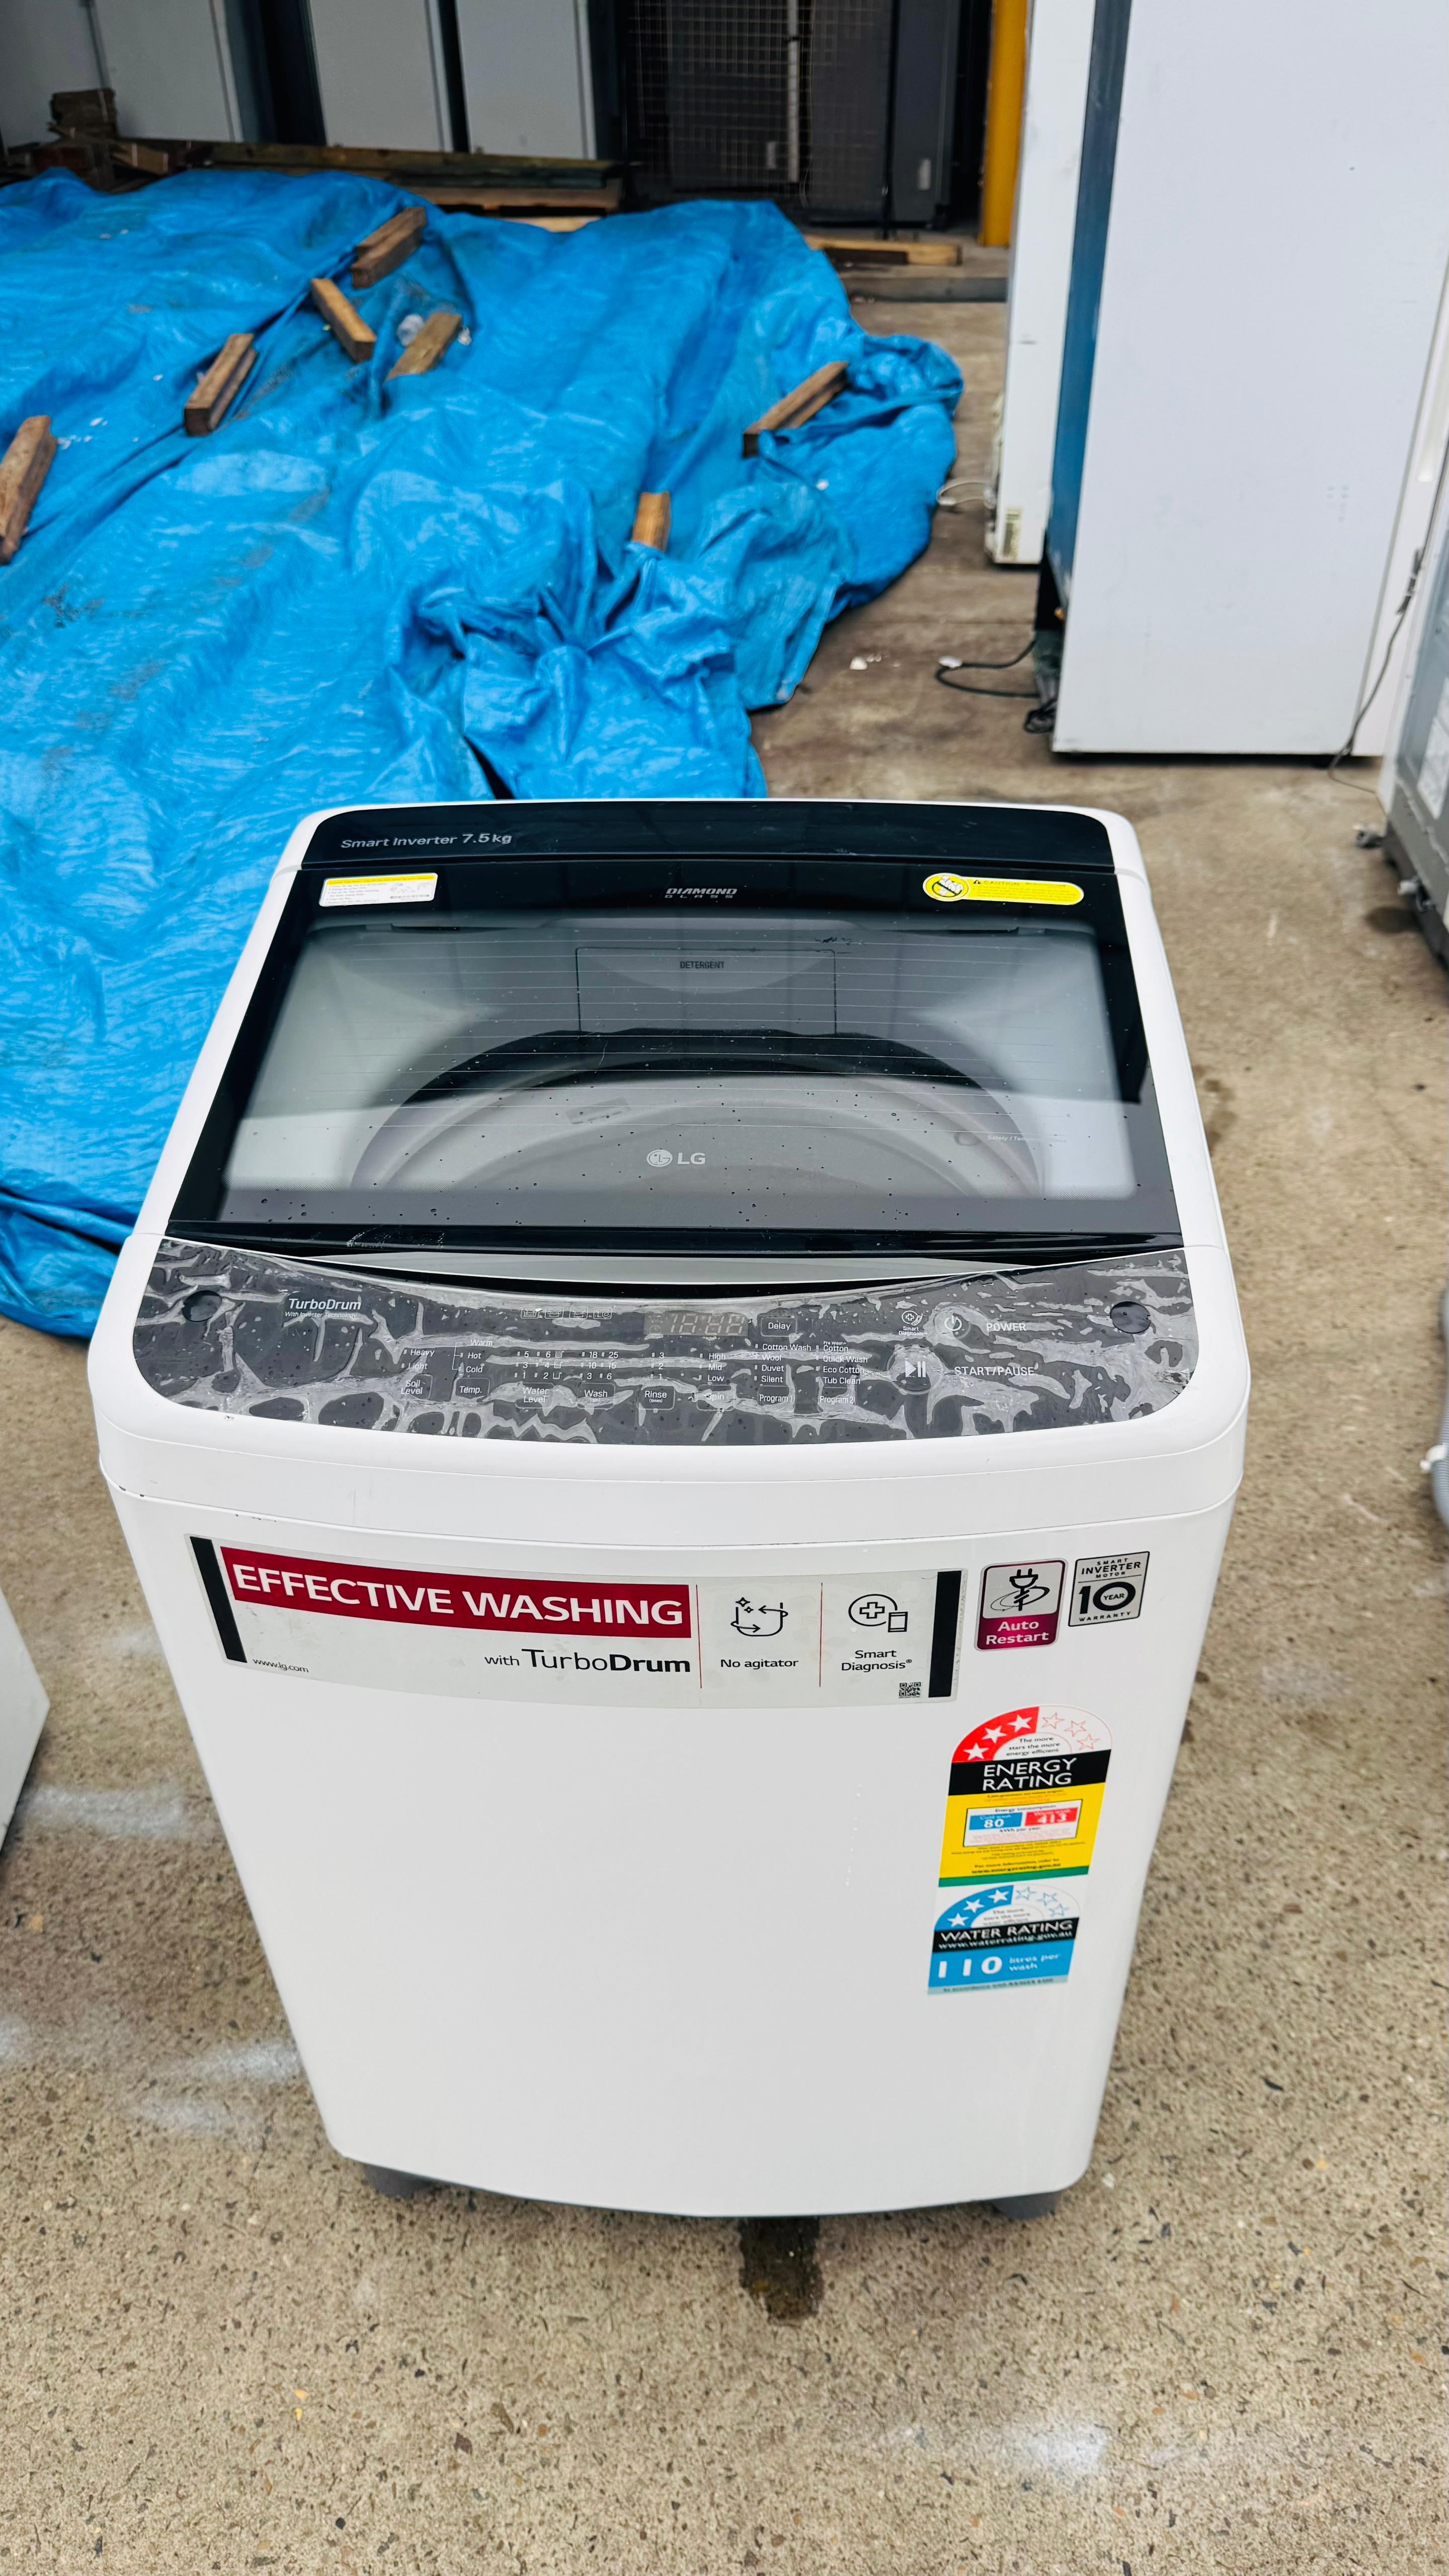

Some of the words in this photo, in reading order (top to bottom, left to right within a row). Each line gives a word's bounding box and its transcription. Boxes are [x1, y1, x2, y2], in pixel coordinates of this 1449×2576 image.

[341, 838, 389, 848] Smart
[393, 835, 457, 847] Inverter
[680, 961, 725, 969] DETERGENT
[677, 1152, 706, 1165] LG
[289, 1298, 362, 1310] TurboDrum
[768, 1322, 791, 1331] Delay
[986, 1323, 1027, 1332] POWER
[411, 1349, 435, 1357] Heavy
[708, 1353, 726, 1361] High
[408, 1362, 428, 1371] Light
[839, 1366, 864, 1374] Cotton
[954, 1366, 1034, 1376] START/PAUSE
[459, 1386, 482, 1395] Temp.
[522, 1387, 549, 1395] Water
[584, 1390, 608, 1398] Wash
[645, 1390, 667, 1398] Rinse
[706, 1392, 725, 1402] Spin
[759, 1394, 788, 1403] Program
[820, 1396, 847, 1404] Program
[1096, 1558, 1129, 1566] SMART
[1081, 1562, 1141, 1575] INVERTER
[232, 1563, 455, 1614] EFFECTIVE
[461, 1590, 683, 1626] WASHING
[1078, 1581, 1137, 1615] 10
[1103, 1592, 1125, 1601] YEAR
[1079, 1611, 1132, 1622] WARRANTY
[997, 1621, 1039, 1632] Auto
[985, 1632, 1050, 1645] Restart
[854, 1649, 898, 1659] Smart
[484, 1654, 520, 1666] with
[521, 1648, 691, 1672] TurboDrum
[720, 1659, 741, 1668] No
[744, 1659, 799, 1670] agitator
[252, 1658, 309, 1673] www.lg.com
[983, 1757, 1077, 1777] ENERGY
[982, 1773, 1072, 1791] RATING
[983, 1818, 1005, 1828] 80
[1037, 1814, 1068, 1824] 413
[940, 1929, 1001, 1943] WATER
[1007, 1919, 1074, 1937] RATING
[1040, 1953, 1061, 1962] per
[937, 1956, 1003, 1978] 110
[1009, 1963, 1038, 1972] wash
